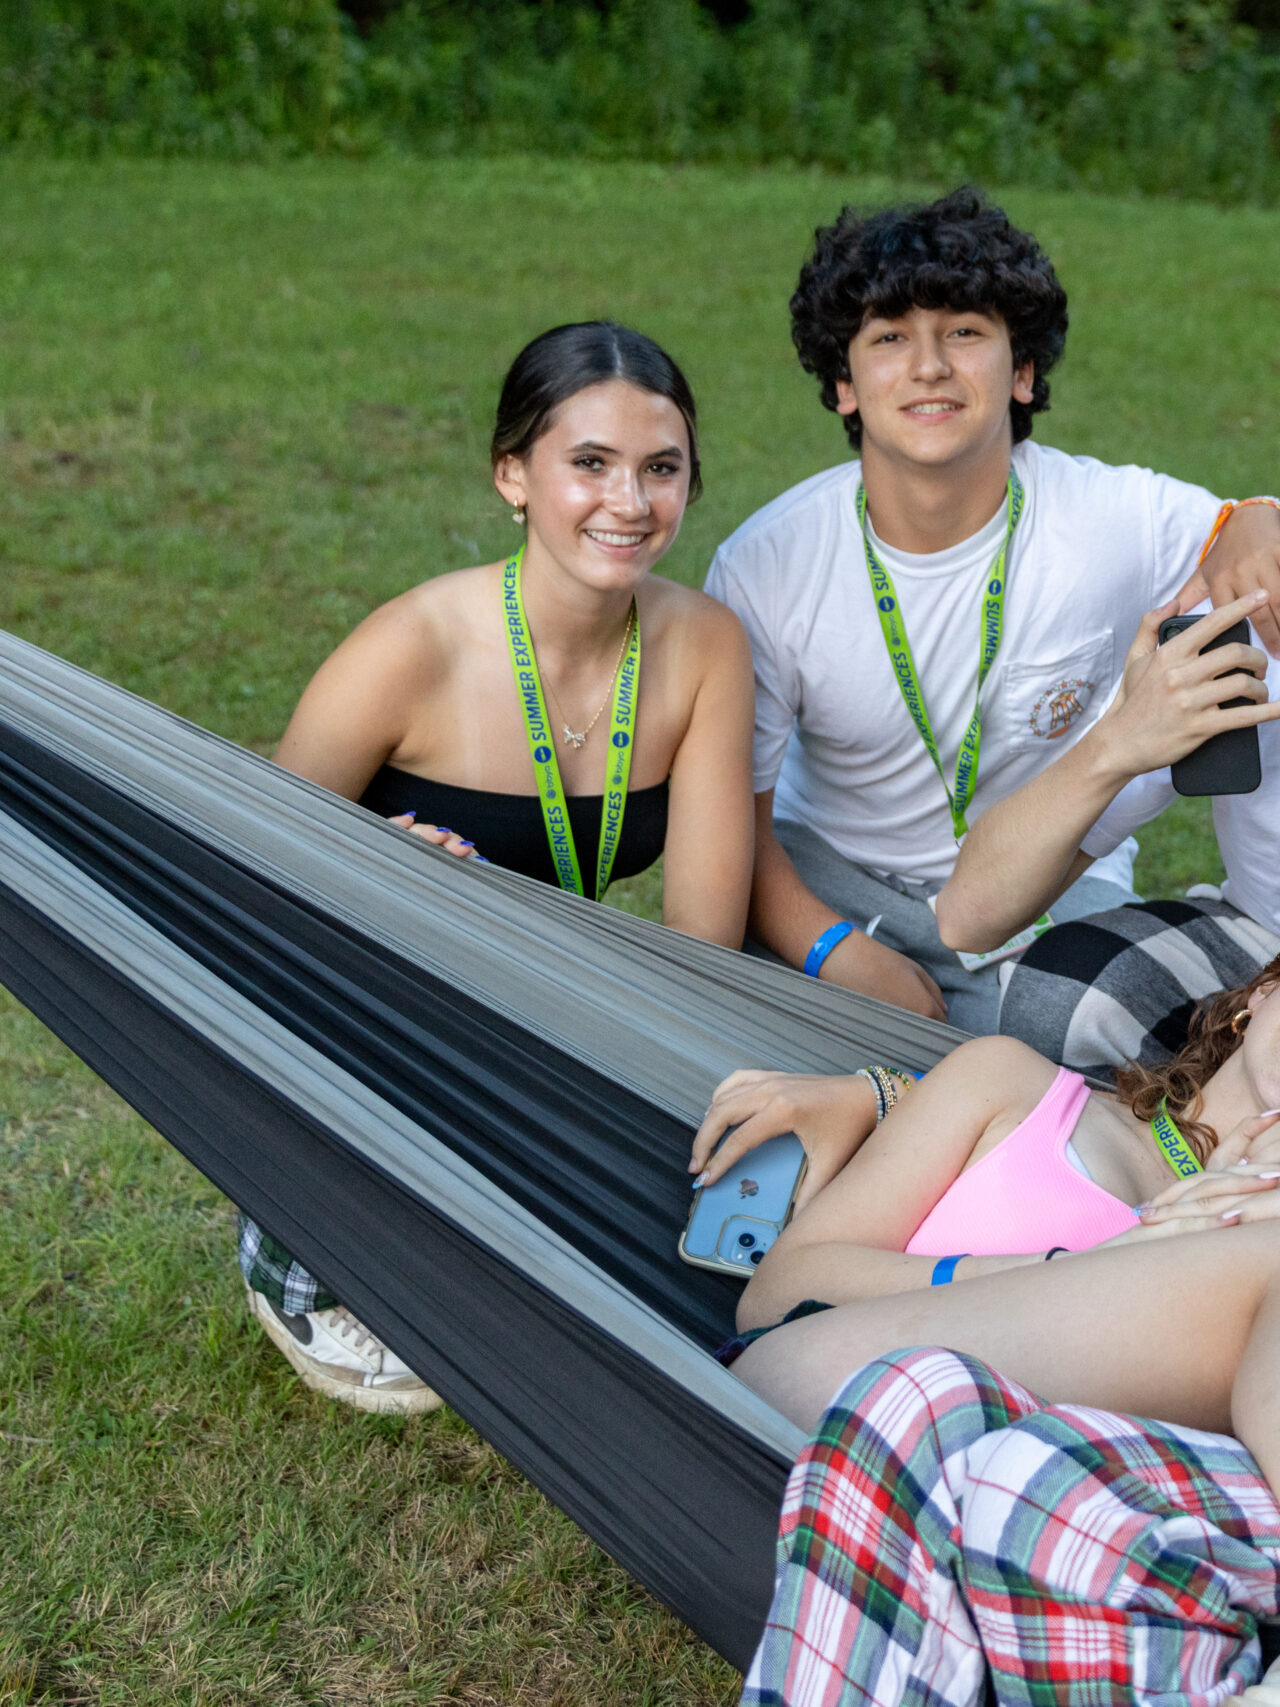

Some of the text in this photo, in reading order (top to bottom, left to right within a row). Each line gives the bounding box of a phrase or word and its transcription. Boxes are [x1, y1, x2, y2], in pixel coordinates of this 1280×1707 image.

[503, 561, 548, 741] SUMMER EXPERIENCES
[615, 656, 637, 726] SUMMER
[954, 751, 975, 813] SUMMER
